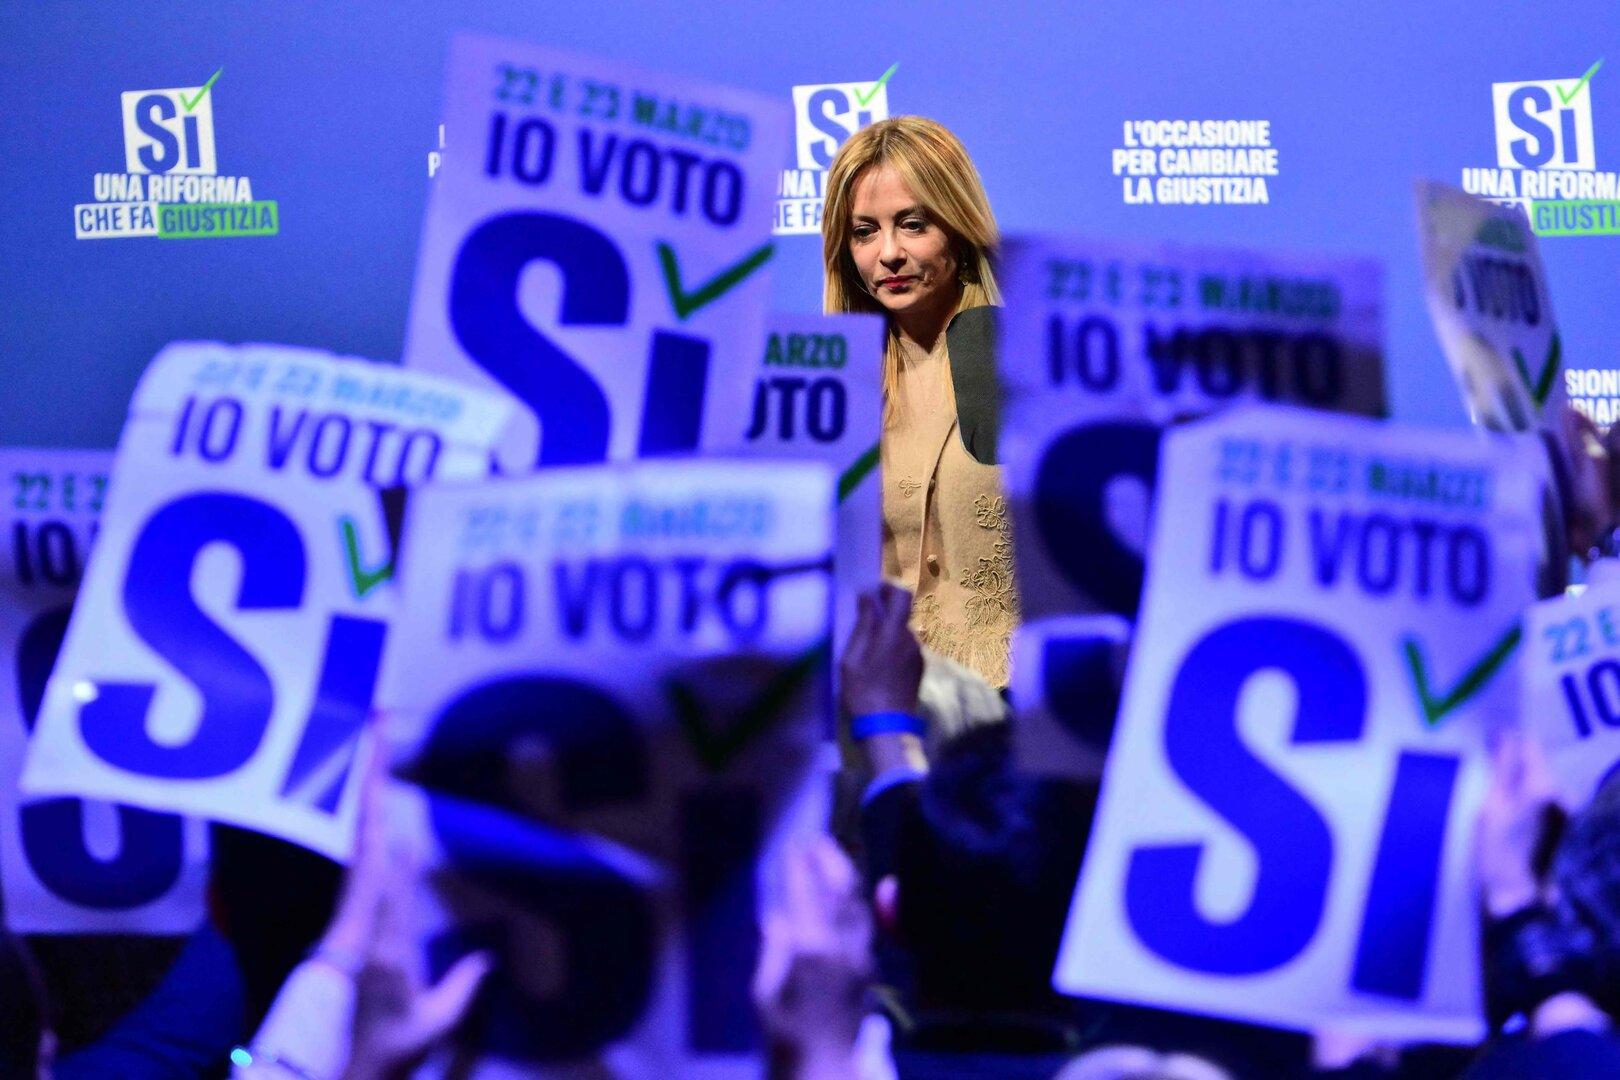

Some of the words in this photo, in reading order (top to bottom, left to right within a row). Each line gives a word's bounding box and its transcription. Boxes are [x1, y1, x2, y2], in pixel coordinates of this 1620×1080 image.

[1123, 119, 1271, 148] L'OCCASIONE
[485, 111, 556, 186] IO
[576, 126, 745, 228] VOTO
[1112, 148, 1158, 176] PER
[1158, 148, 1280, 176] CAMBIARE
[94, 172, 145, 202] UNA
[147, 174, 254, 205] RIFORMA
[776, 169, 817, 198] NA
[1122, 176, 1154, 205] LA
[1156, 176, 1270, 205] GIUSTIZIA
[1462, 167, 1517, 199] UNA
[79, 207, 124, 233] CHE
[128, 205, 155, 231] FA
[160, 204, 274, 234] GIUSTIZIA
[1535, 204, 1620, 232] GIUSTI
[763, 332, 848, 371] ARZO
[1047, 312, 1121, 395] IO
[1145, 320, 1341, 412] VOTO
[1564, 368, 1620, 397] SION
[745, 376, 848, 443] TO
[172, 394, 243, 462] IO
[266, 402, 443, 480] VOTO
[88, 472, 109, 513] 2
[14, 520, 77, 587] IO
[1208, 496, 1284, 583] IO
[1307, 505, 1491, 609] VOTO
[446, 560, 525, 645] IO
[552, 555, 769, 648] VOTO
